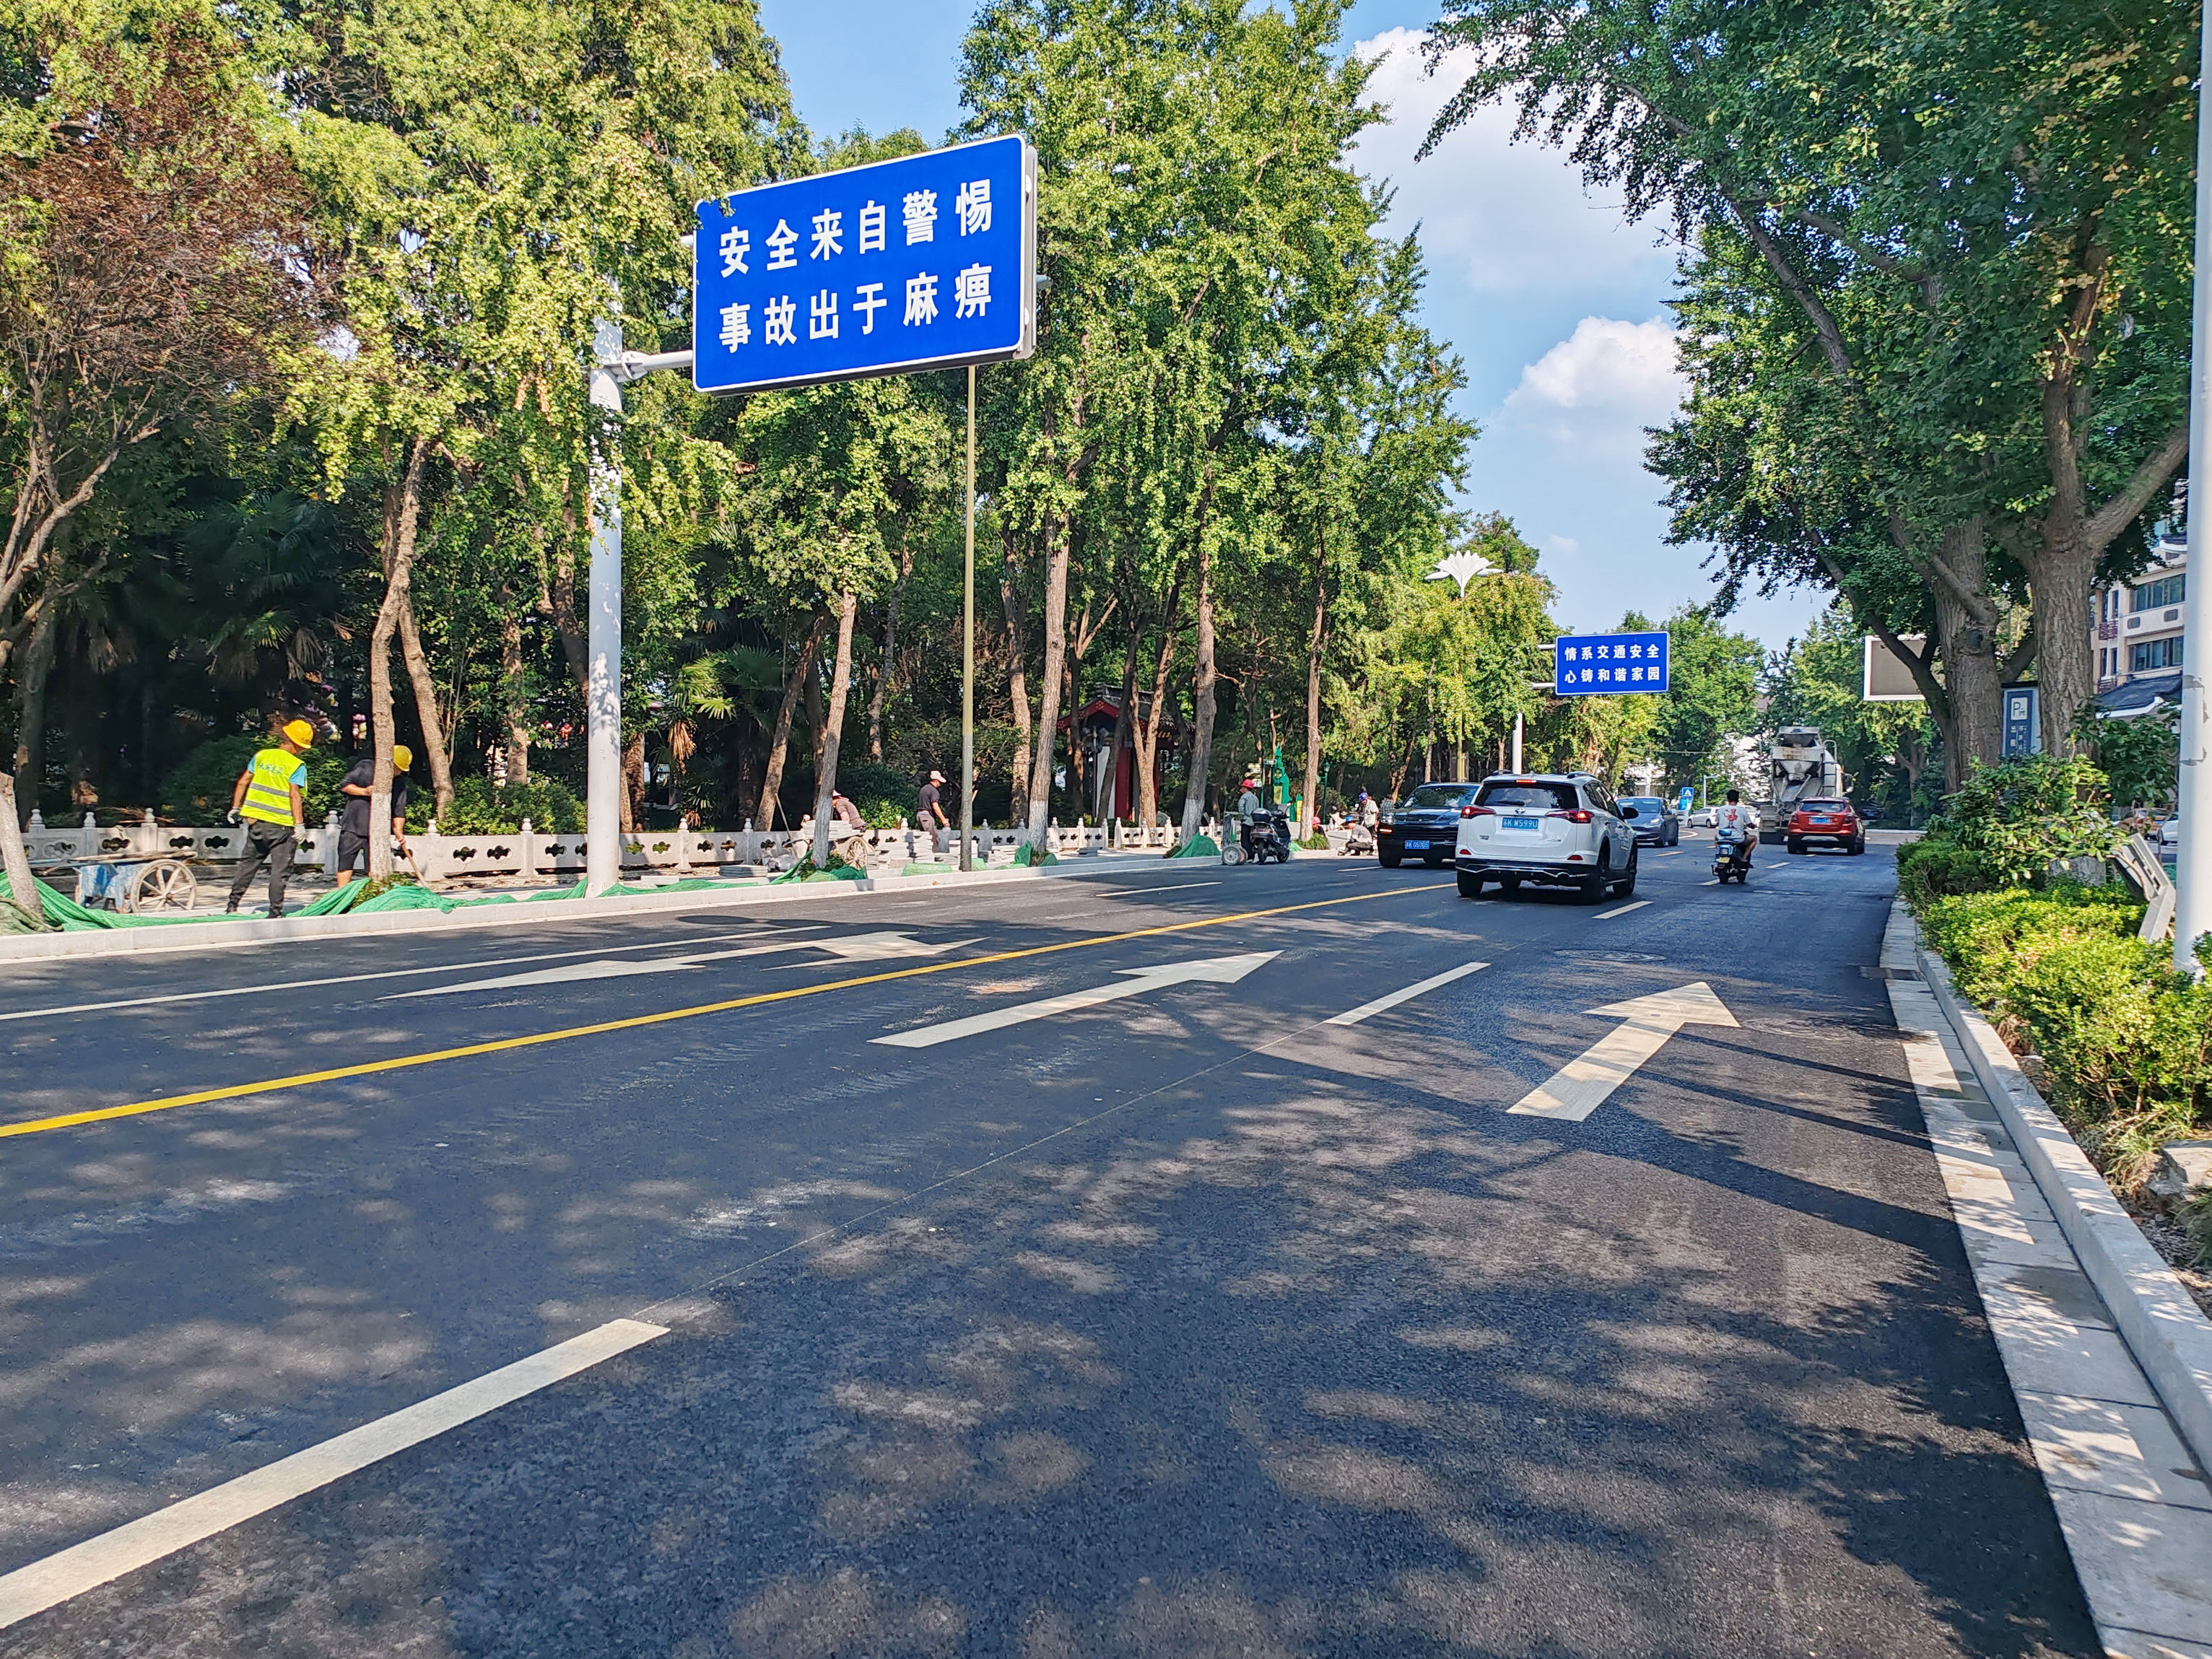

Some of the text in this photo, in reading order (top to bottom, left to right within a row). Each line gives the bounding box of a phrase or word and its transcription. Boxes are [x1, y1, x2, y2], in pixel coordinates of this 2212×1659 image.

[718, 178, 992, 279] 安全来自警惕
[718, 263, 992, 353] 事故出于麻痹
[1564, 643, 1660, 661] 情系交通安全
[1564, 666, 1660, 684] 心铸和谐家园
